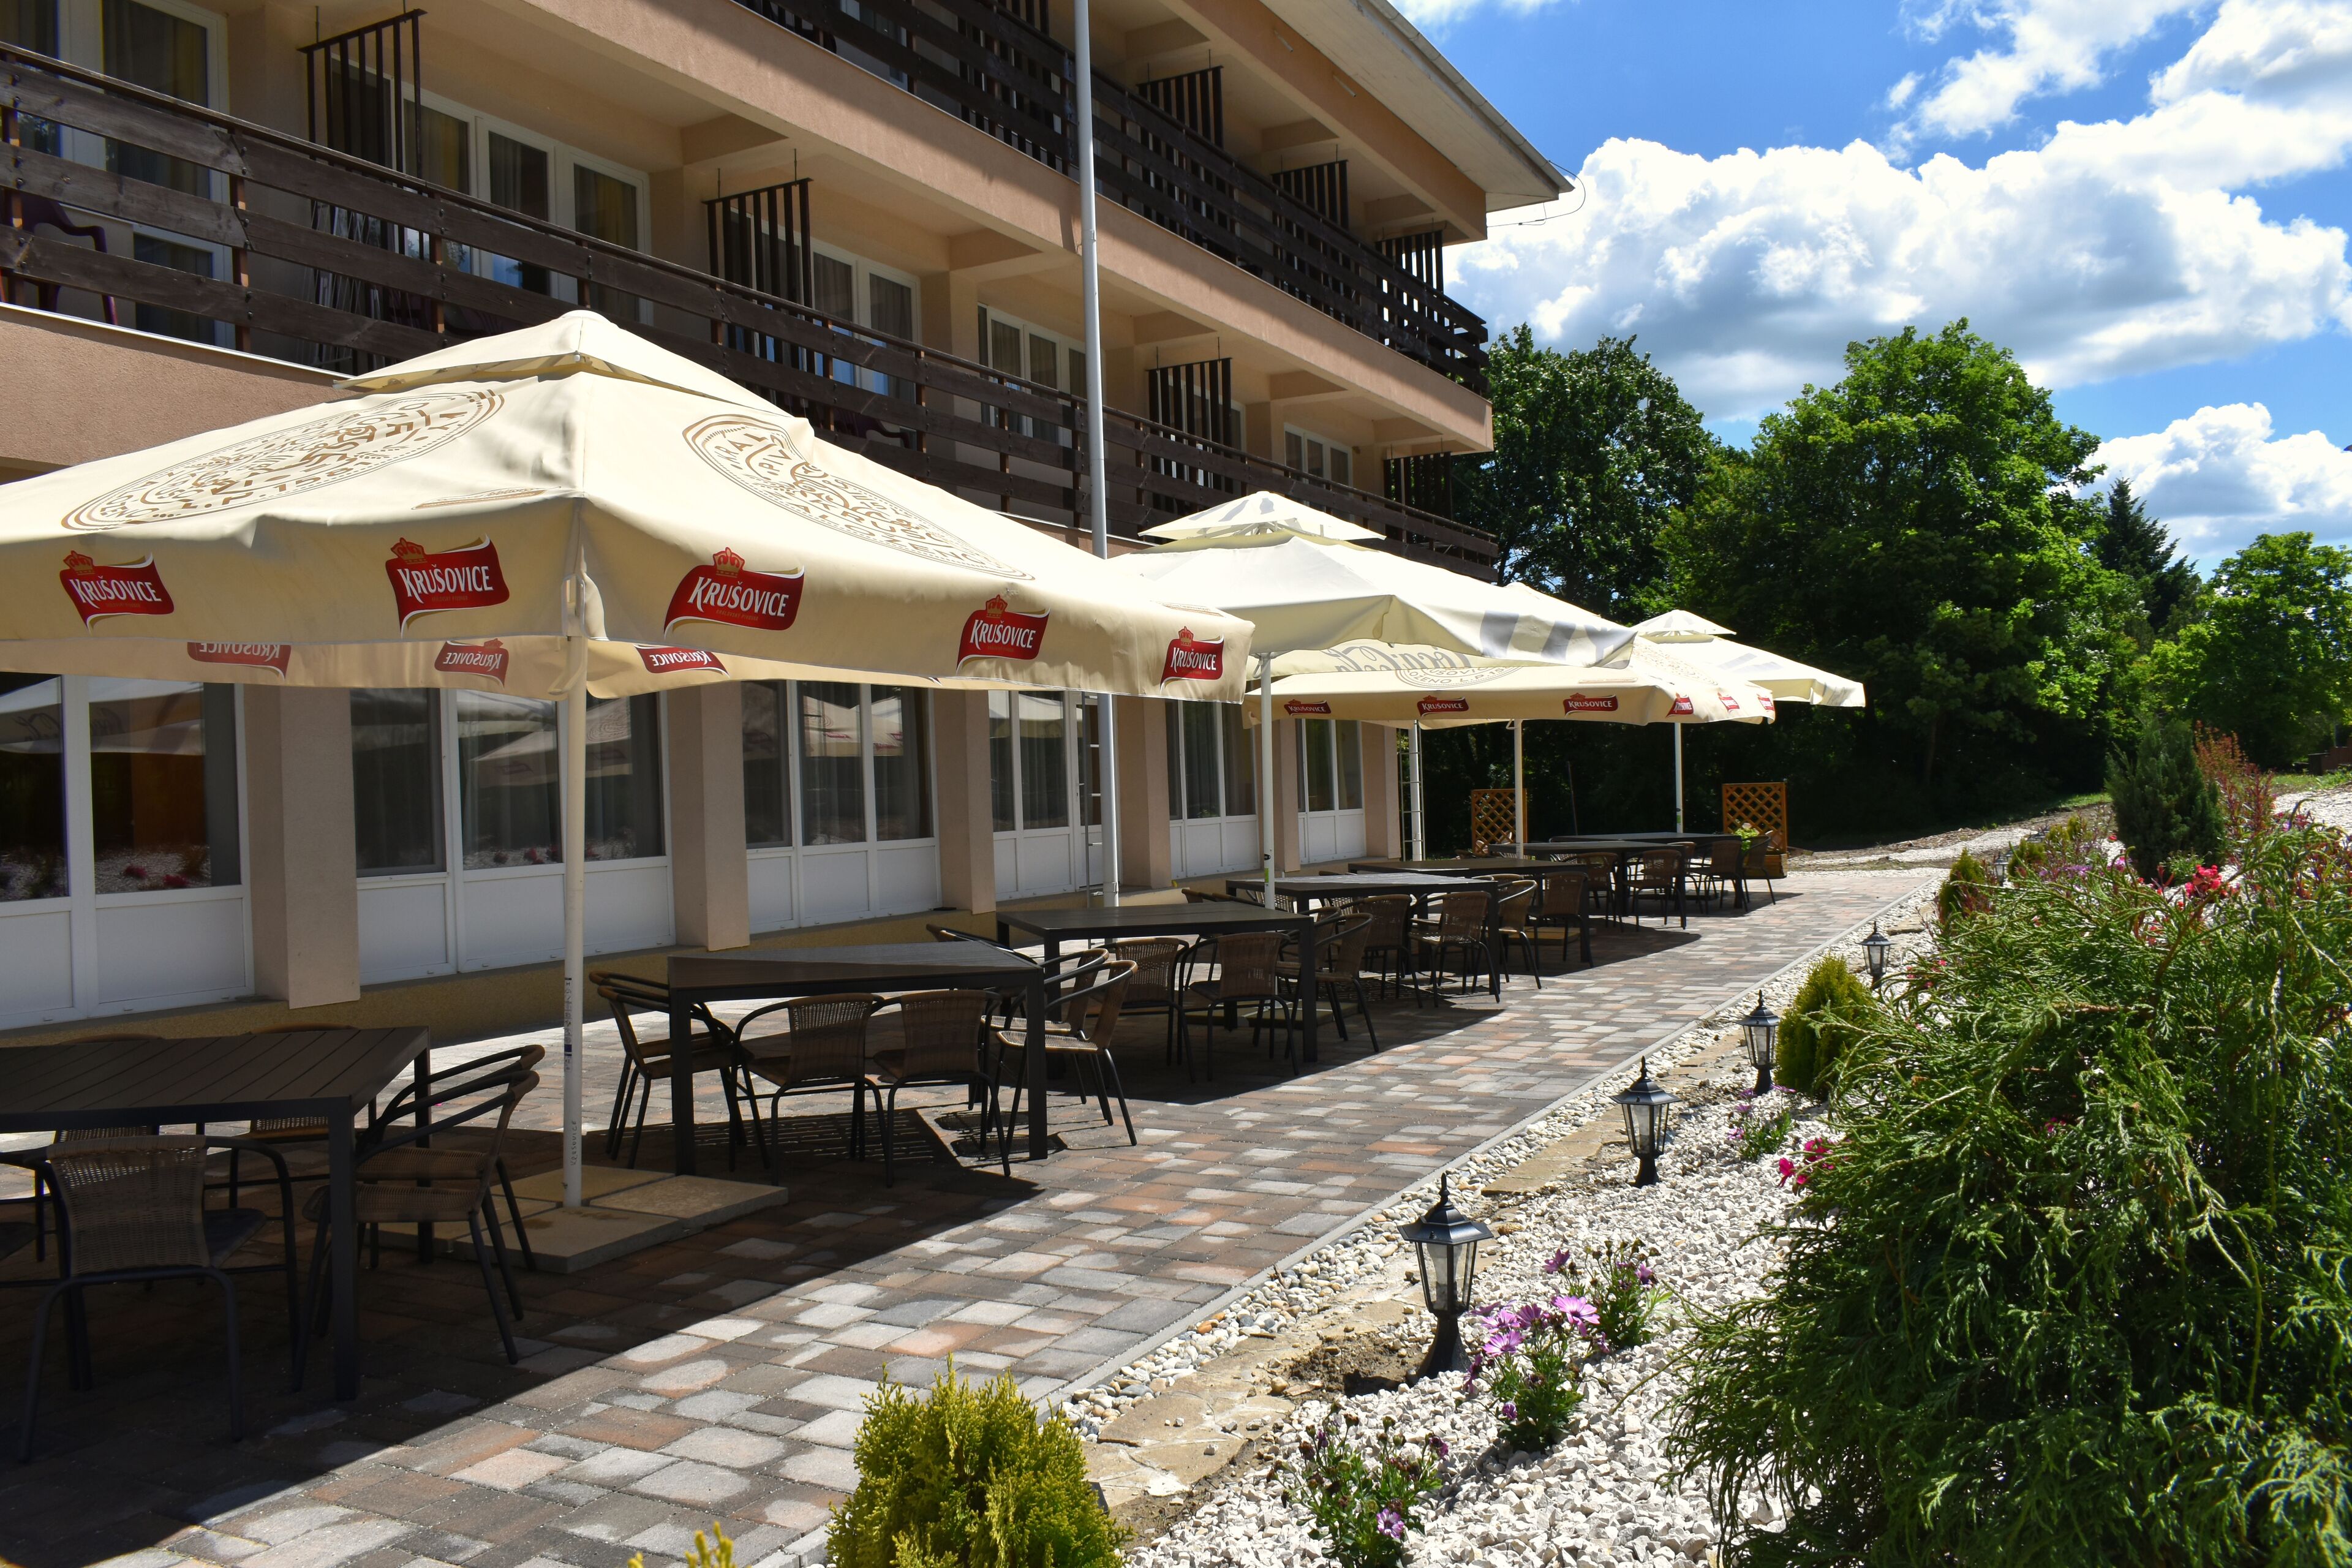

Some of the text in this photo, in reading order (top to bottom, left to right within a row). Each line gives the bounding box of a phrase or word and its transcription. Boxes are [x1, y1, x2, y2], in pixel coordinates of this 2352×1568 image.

[69, 576, 162, 609] KRUŠOVICE
[397, 564, 494, 604] KRUŠOVICE
[688, 576, 789, 617] KRUŠOVICE
[970, 619, 1036, 650] KRUŠOVICE
[1170, 647, 1216, 673] KRUŠOVICE
